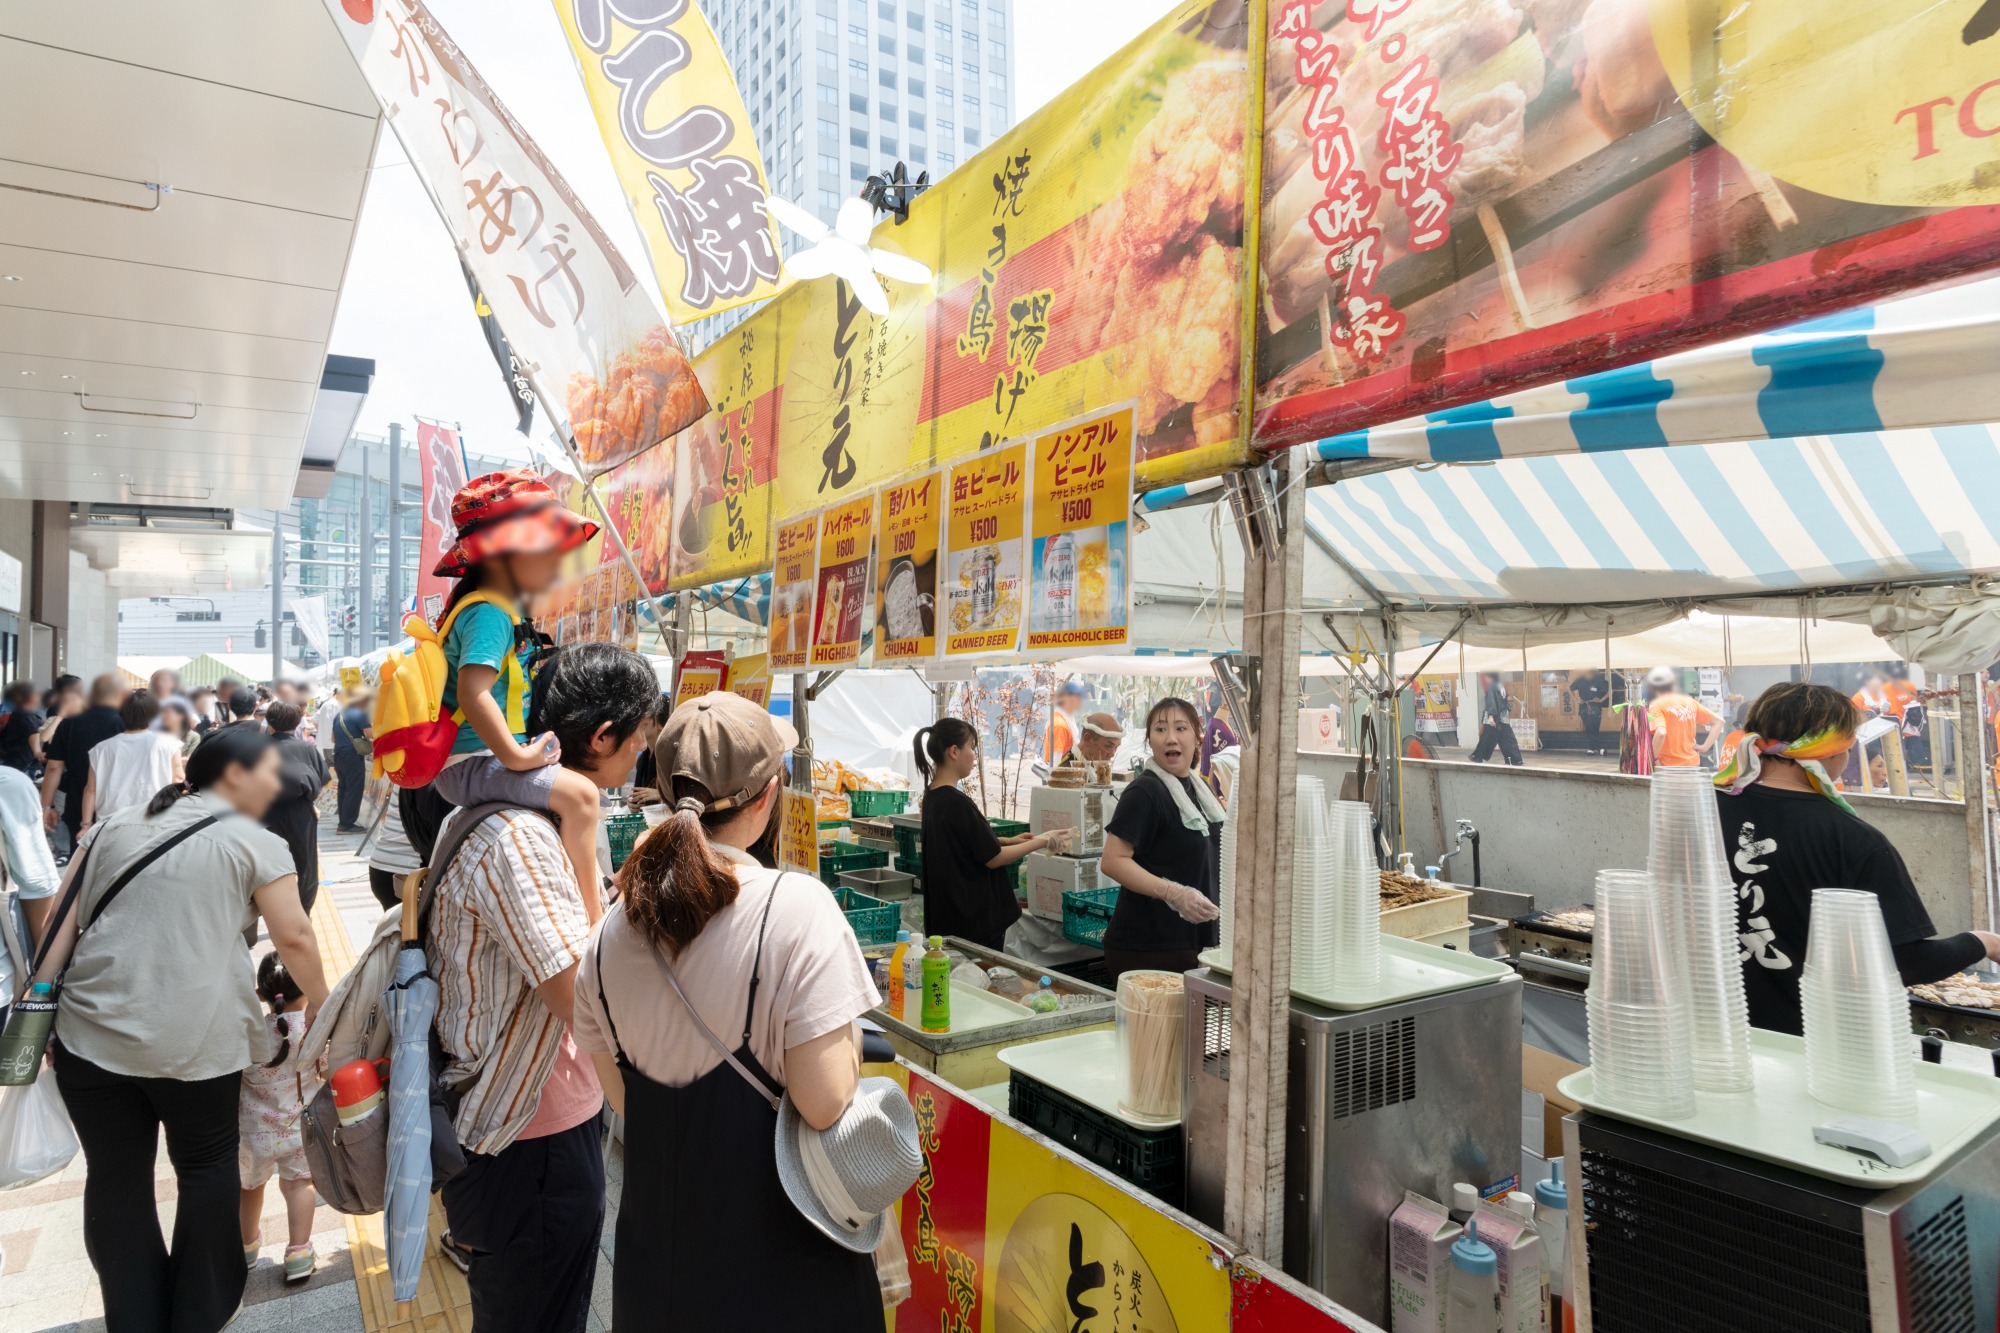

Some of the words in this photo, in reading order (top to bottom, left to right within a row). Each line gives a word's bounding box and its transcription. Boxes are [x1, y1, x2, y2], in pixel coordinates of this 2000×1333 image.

[384, 9, 587, 329] からあげ
[1046, 419, 1118, 463] ノンアル
[953, 459, 1021, 503] 缶ビール
[1053, 452, 1108, 487] ビール
[888, 478, 932, 518] 酎ハイ
[1049, 479, 1105, 502] アサヒドライゼロ
[823, 507, 872, 537] ハイボール
[1061, 498, 1092, 524] ¥500
[777, 522, 816, 552] 生ビール
[894, 529, 916, 555] ¥600
[969, 514, 998, 544] ¥500
[835, 536, 855, 559] ¥600
[883, 640, 919, 657] CHUHAI
[951, 634, 985, 650] CANNED
[986, 633, 1008, 646] BEER
[1029, 630, 1102, 645] NON-ALCOHOLIC
[1103, 628, 1125, 641] BEER
[772, 653, 793, 666] DRAFT
[815, 643, 857, 662] HIGHBALL
[1733, 820, 1793, 971] とり元
[1396, 1281, 1426, 1307] Fruits
[1396, 1297, 1420, 1316] Ade
